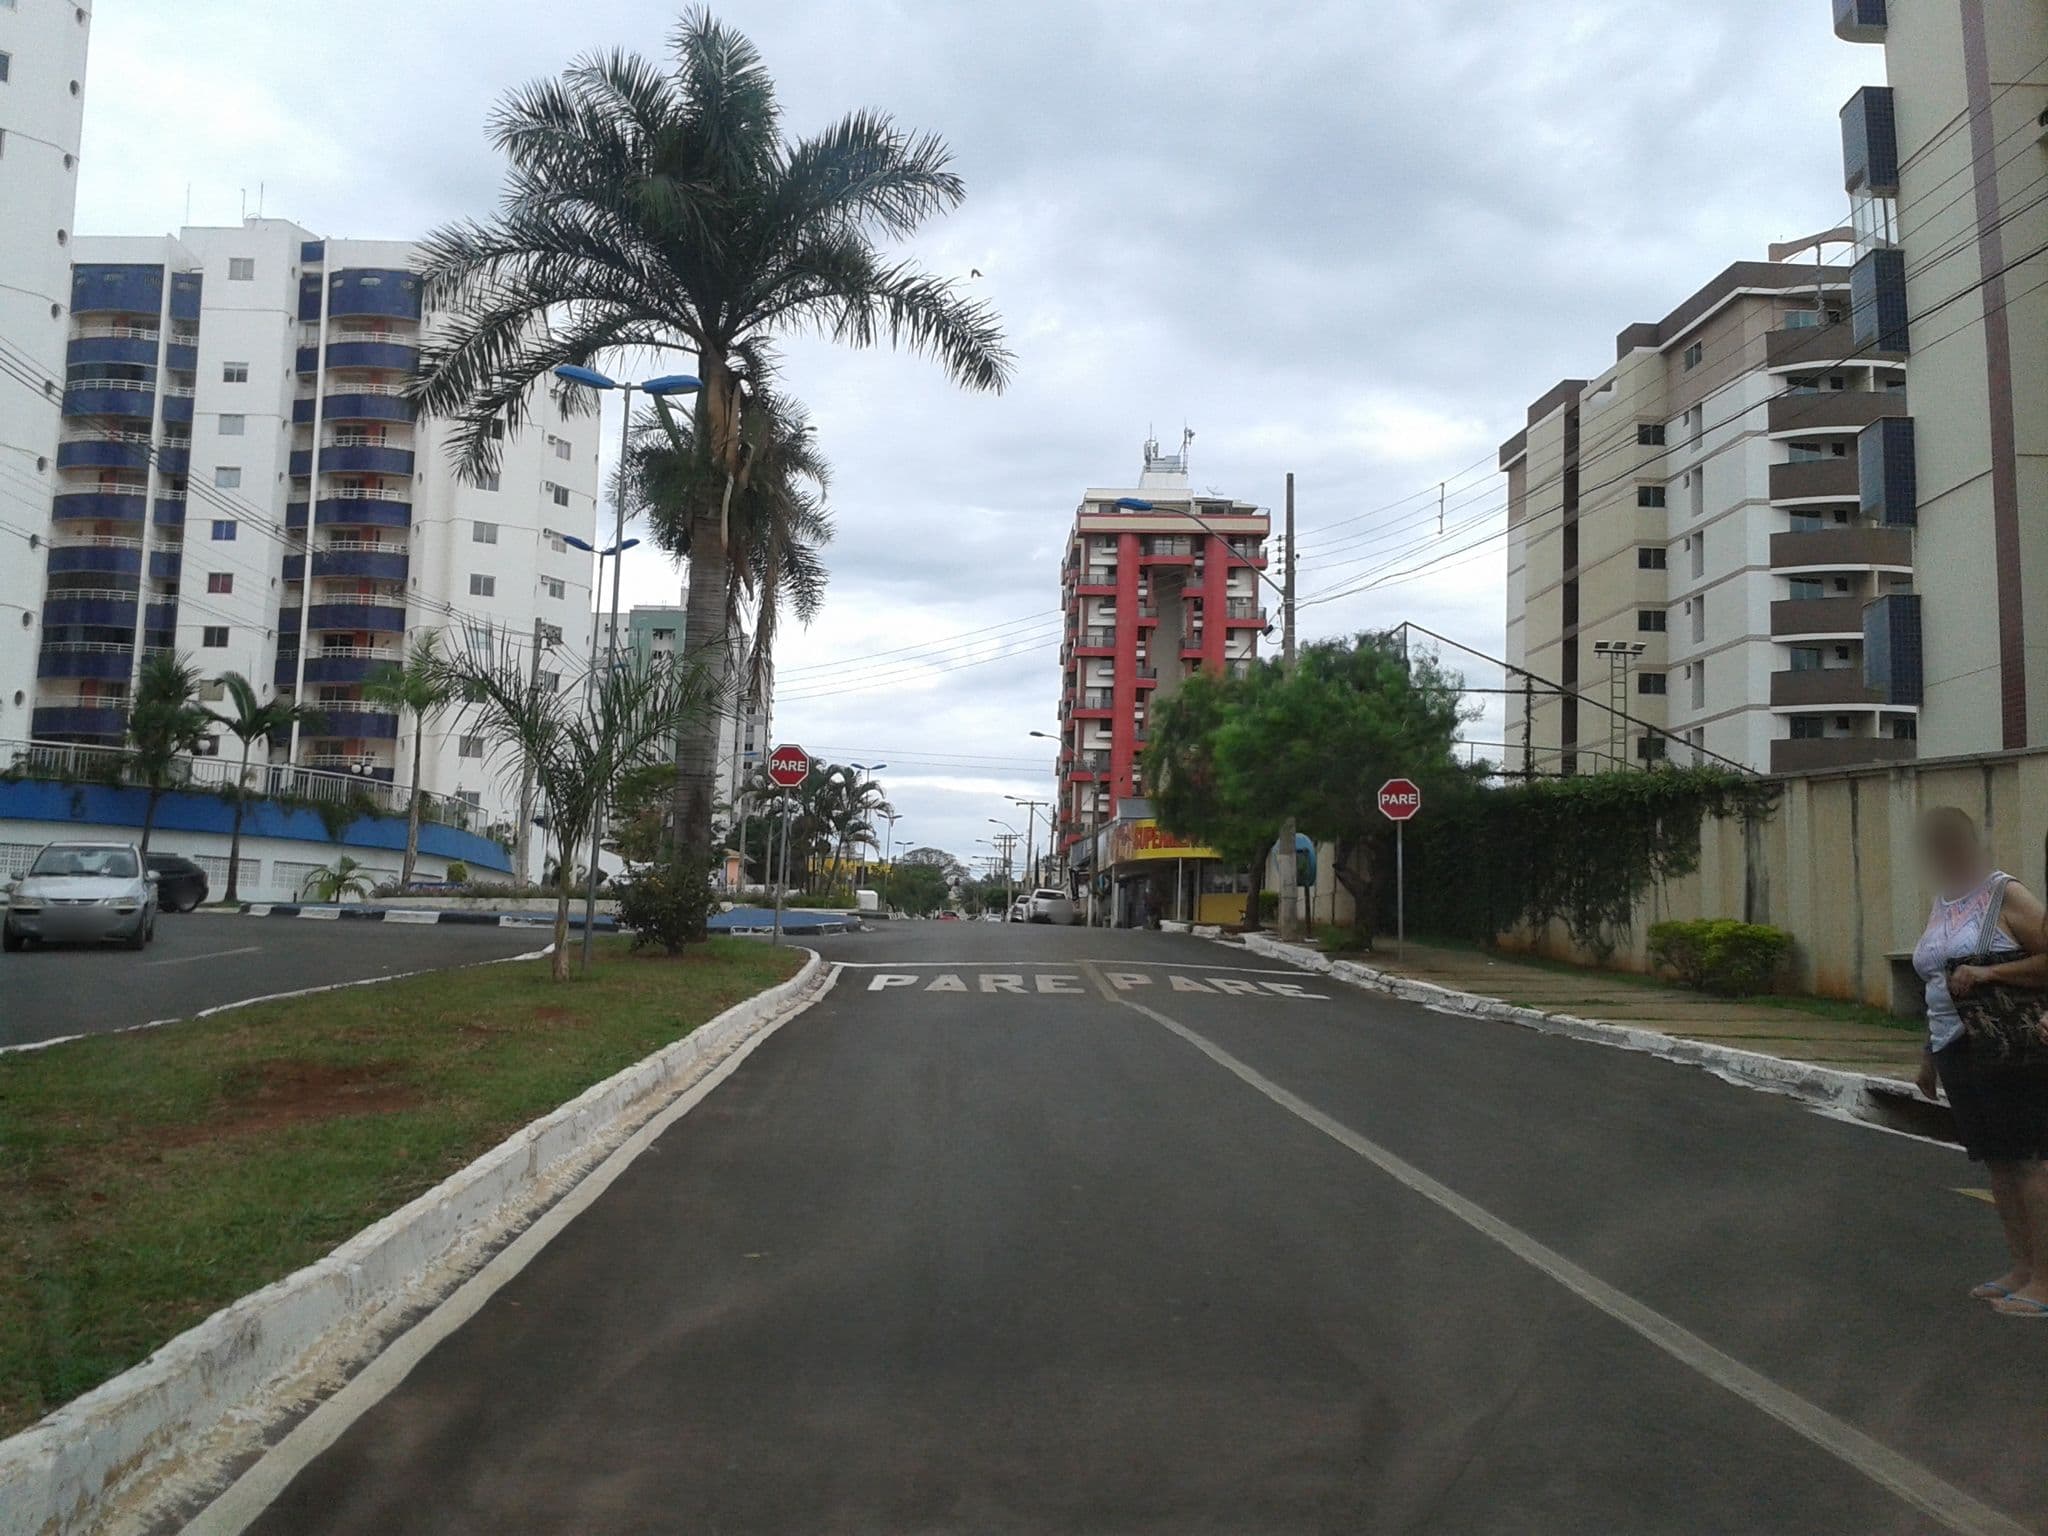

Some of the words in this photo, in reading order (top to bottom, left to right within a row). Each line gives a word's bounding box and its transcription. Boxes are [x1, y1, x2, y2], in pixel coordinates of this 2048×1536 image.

[771, 759, 806, 772] PARE
[1382, 793, 1417, 805] PARE
[867, 974, 1085, 993] PARE
[1105, 972, 1332, 1000] PARE
